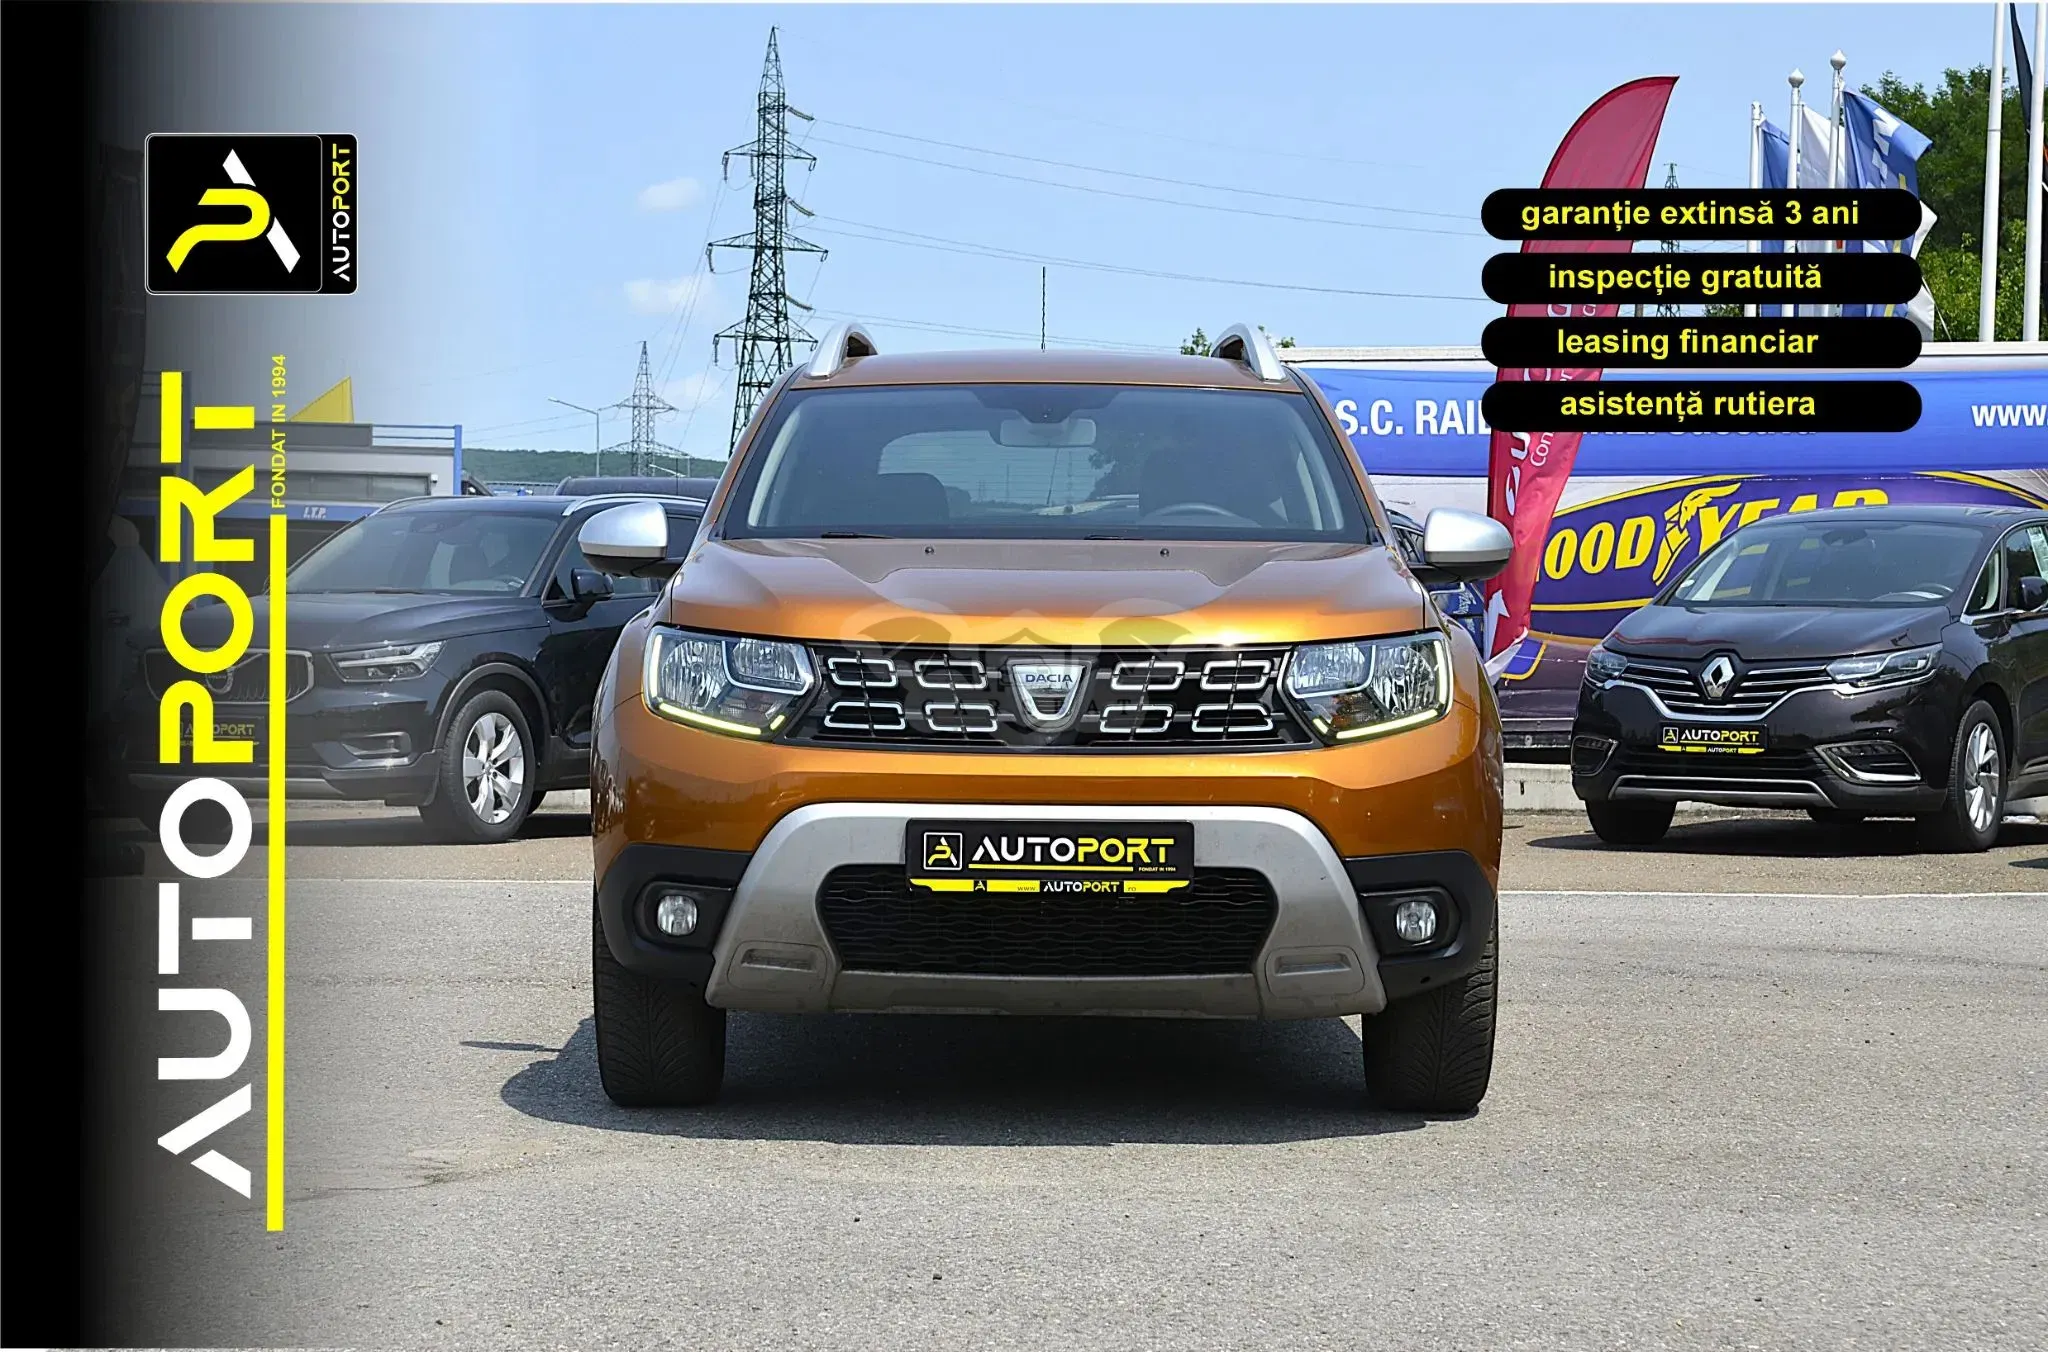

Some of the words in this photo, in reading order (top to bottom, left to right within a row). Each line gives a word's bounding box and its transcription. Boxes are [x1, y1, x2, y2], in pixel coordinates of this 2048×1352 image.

[1335, 399, 1404, 435] S.C.
[1025, 674, 1073, 683] DACIA
[1681, 729, 1760, 742] AUTOPORT
[971, 836, 1175, 863] AUTOPORT
[1043, 880, 1120, 893] AUTOPORT
